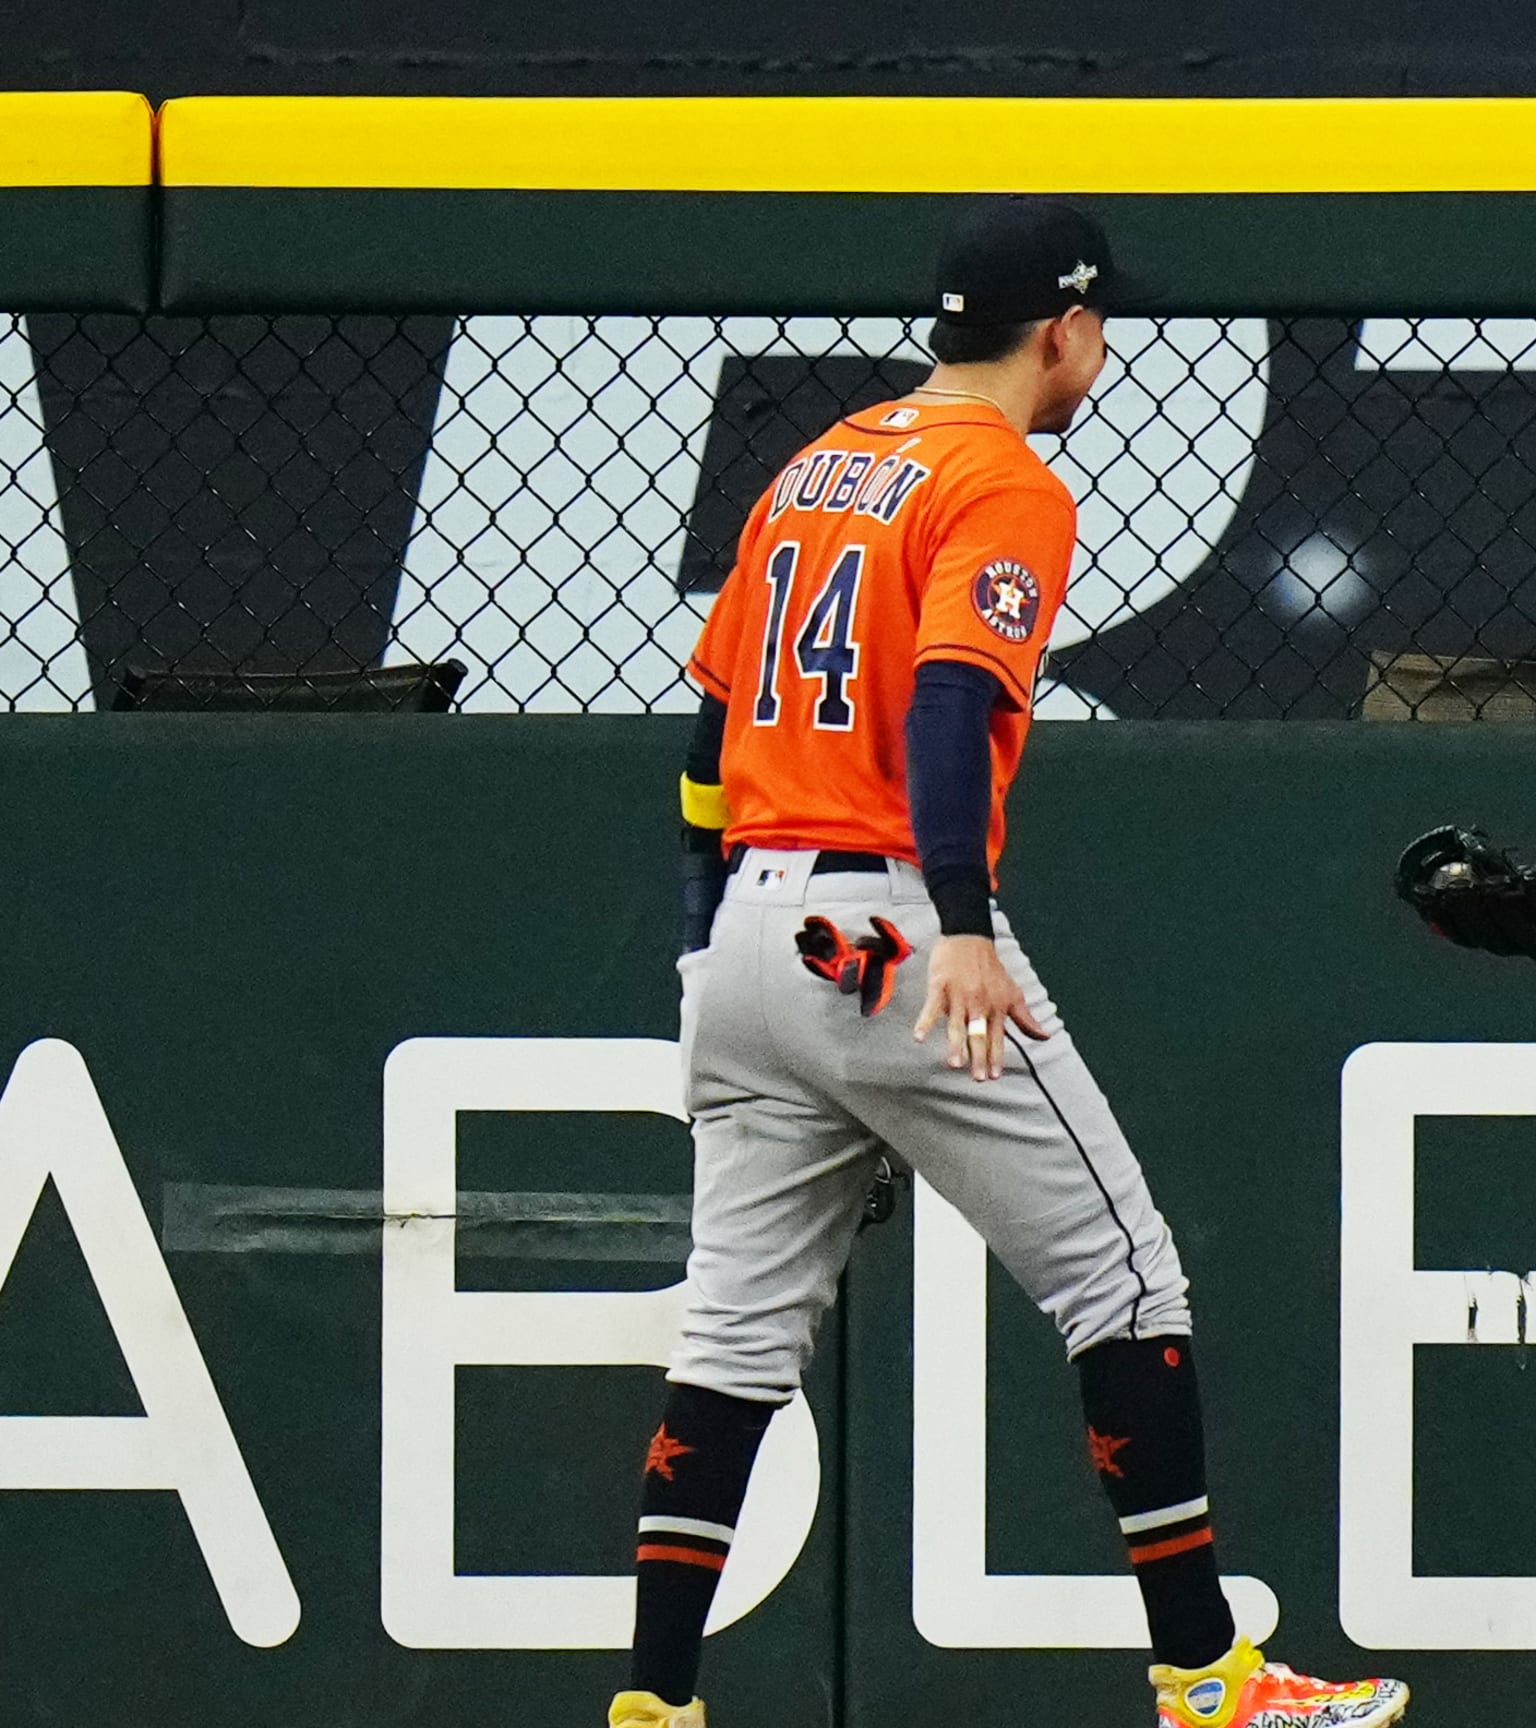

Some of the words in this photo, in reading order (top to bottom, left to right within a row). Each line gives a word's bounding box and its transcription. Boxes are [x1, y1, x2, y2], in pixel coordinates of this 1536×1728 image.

[767, 437, 932, 526] DUBÓN
[984, 560, 1039, 598] HOUSTON
[752, 540, 866, 732] 14
